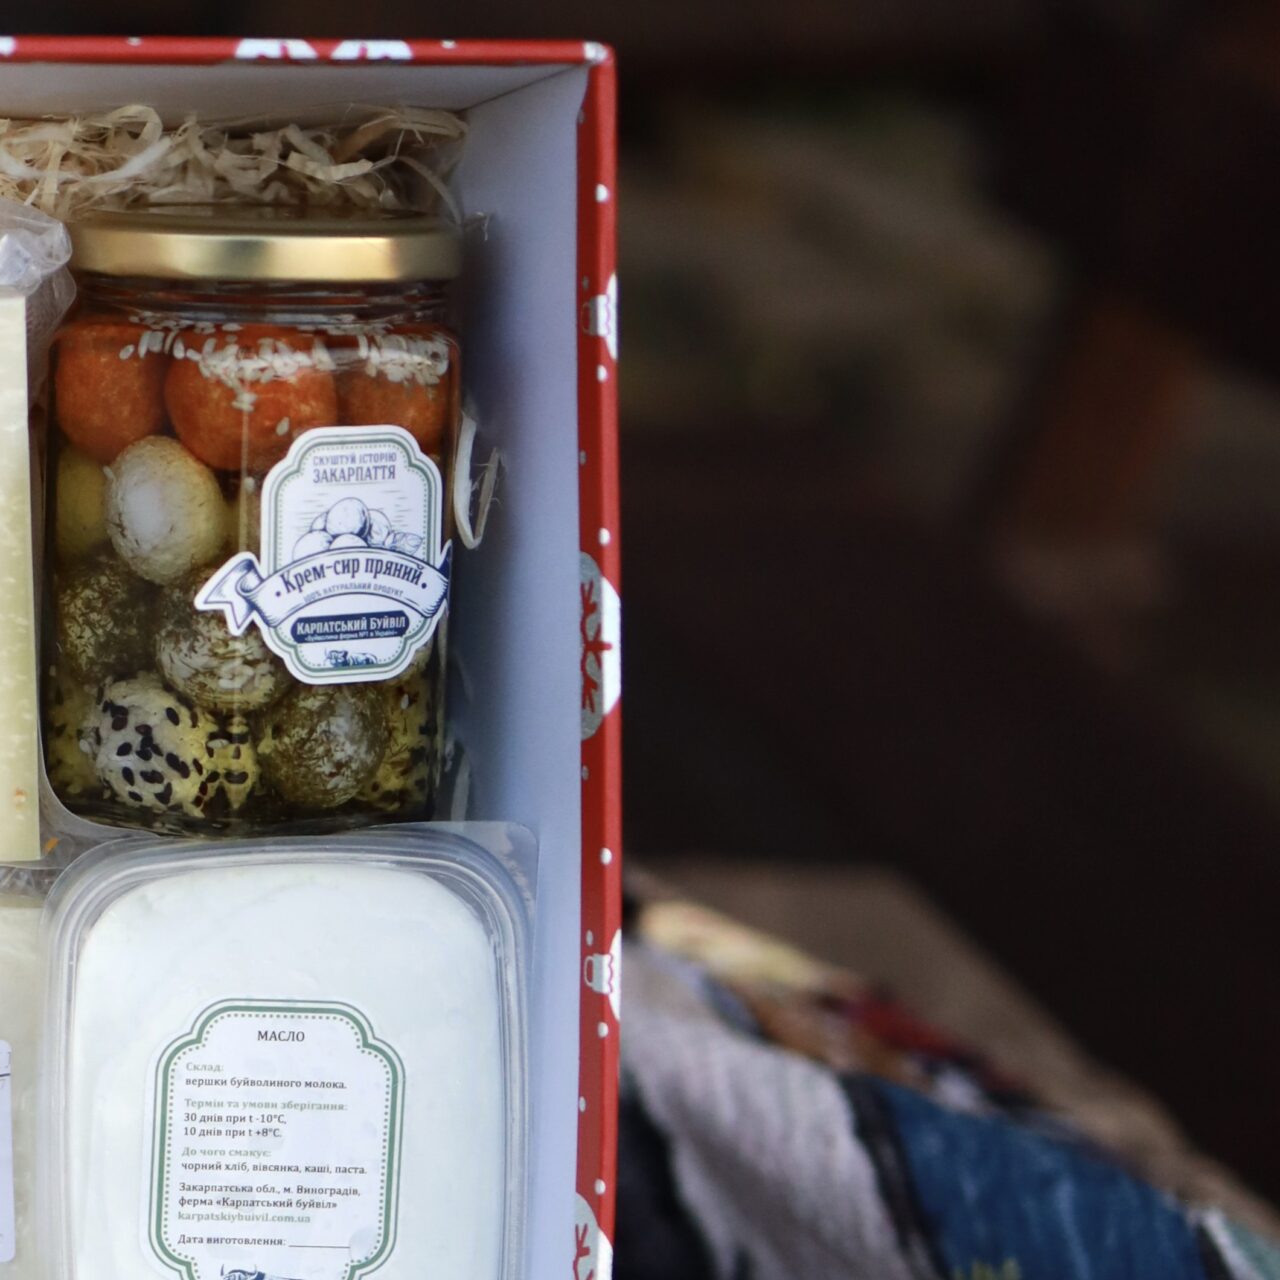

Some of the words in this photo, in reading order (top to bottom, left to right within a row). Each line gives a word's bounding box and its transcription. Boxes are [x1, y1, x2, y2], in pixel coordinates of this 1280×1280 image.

[313, 453, 356, 466] СКУШТУЙ
[359, 452, 397, 464] ІСТОРІЮ
[313, 465, 396, 484] ЗАКАРПАТТЯ
[280, 558, 360, 594] Крем-сир
[364, 558, 425, 586] пряний
[323, 582, 371, 596] НАТУРАЛЬНИЙ
[373, 584, 404, 598] ПРОДУКТ
[296, 617, 367, 635] КАРПАТСЬКИЙ
[369, 616, 406, 630] БУЙВІЛ
[256, 1030, 306, 1043] МАСЛО
[185, 1062, 224, 1073] Склад:
[185, 1078, 227, 1088] вершки
[230, 1077, 302, 1090] буйволиного
[304, 1080, 347, 1090] молока.
[184, 1098, 224, 1110] Термін
[227, 1101, 240, 1109] та
[242, 1101, 278, 1111] умови
[280, 1100, 348, 1112] зберігання:
[183, 1113, 197, 1122] 30
[199, 1113, 223, 1124] днів
[226, 1115, 246, 1125] при
[248, 1114, 253, 1123] t
[183, 1126, 196, 1136] 10
[199, 1127, 222, 1138] днів
[225, 1129, 245, 1139] при
[248, 1128, 253, 1137] t
[181, 1147, 197, 1157] До
[199, 1149, 226, 1157] чого
[228, 1149, 272, 1159] смакує:
[181, 1162, 222, 1172] чорний
[224, 1162, 250, 1173] хліб,
[252, 1163, 302, 1174] вівсянка,
[304, 1165, 332, 1175] каші,
[335, 1166, 368, 1175] паста.
[179, 1182, 253, 1194] Закарпатська
[255, 1184, 280, 1195] обл.,
[296, 1186, 361, 1197] Виноградів,
[178, 1197, 213, 1208] ферма
[216, 1197, 293, 1209] «Карпатський
[295, 1198, 338, 1210] буйвіл»
[177, 1235, 204, 1245] Дата
[206, 1237, 287, 1246] виготовлення:
